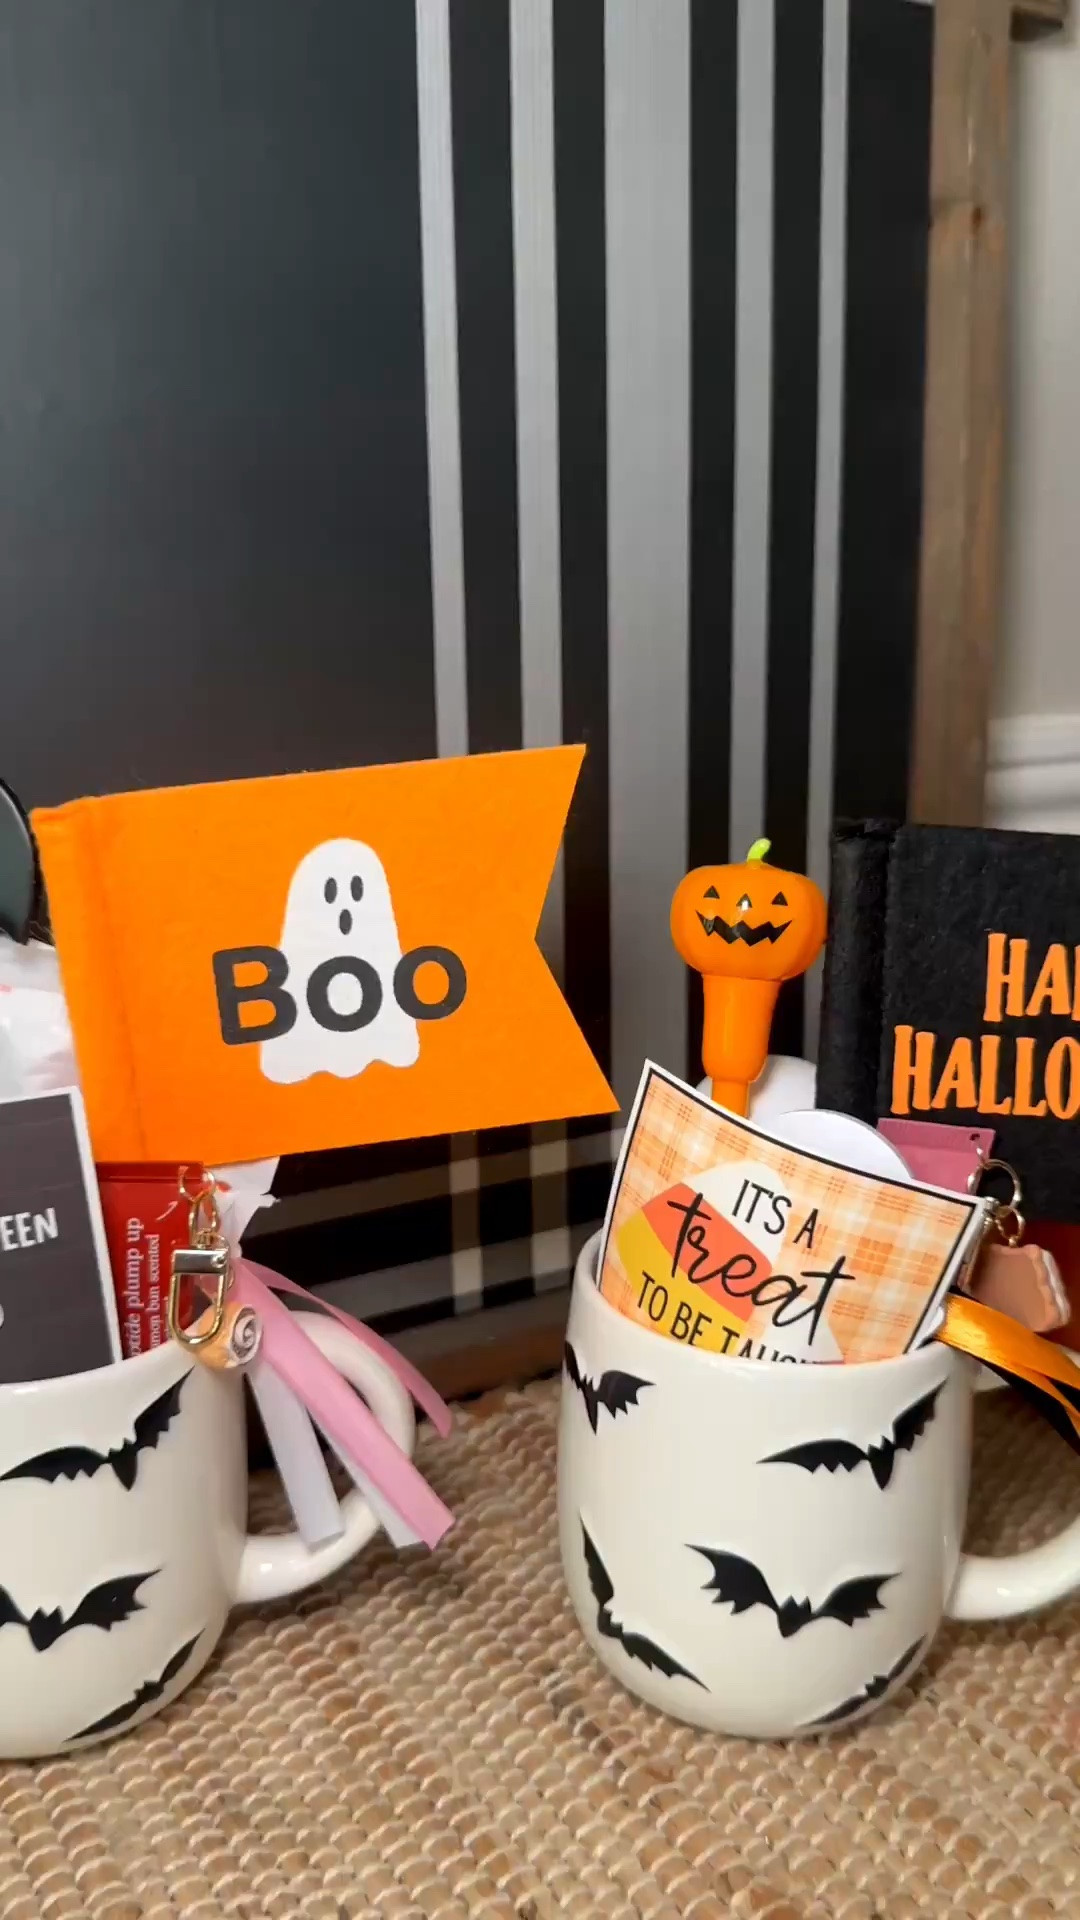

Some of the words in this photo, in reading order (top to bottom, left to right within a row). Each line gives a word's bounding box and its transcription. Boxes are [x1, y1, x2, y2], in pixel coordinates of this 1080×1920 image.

[126, 1217, 145, 1243] up
[731, 1178, 793, 1235] IT'S
[792, 1207, 819, 1249] A
[122, 1247, 145, 1309] plump
[145, 1233, 160, 1284] scented
[666, 1191, 856, 1347] treat
[145, 1285, 160, 1313] bun
[636, 1270, 669, 1322] TO
[669, 1300, 713, 1347] BE
